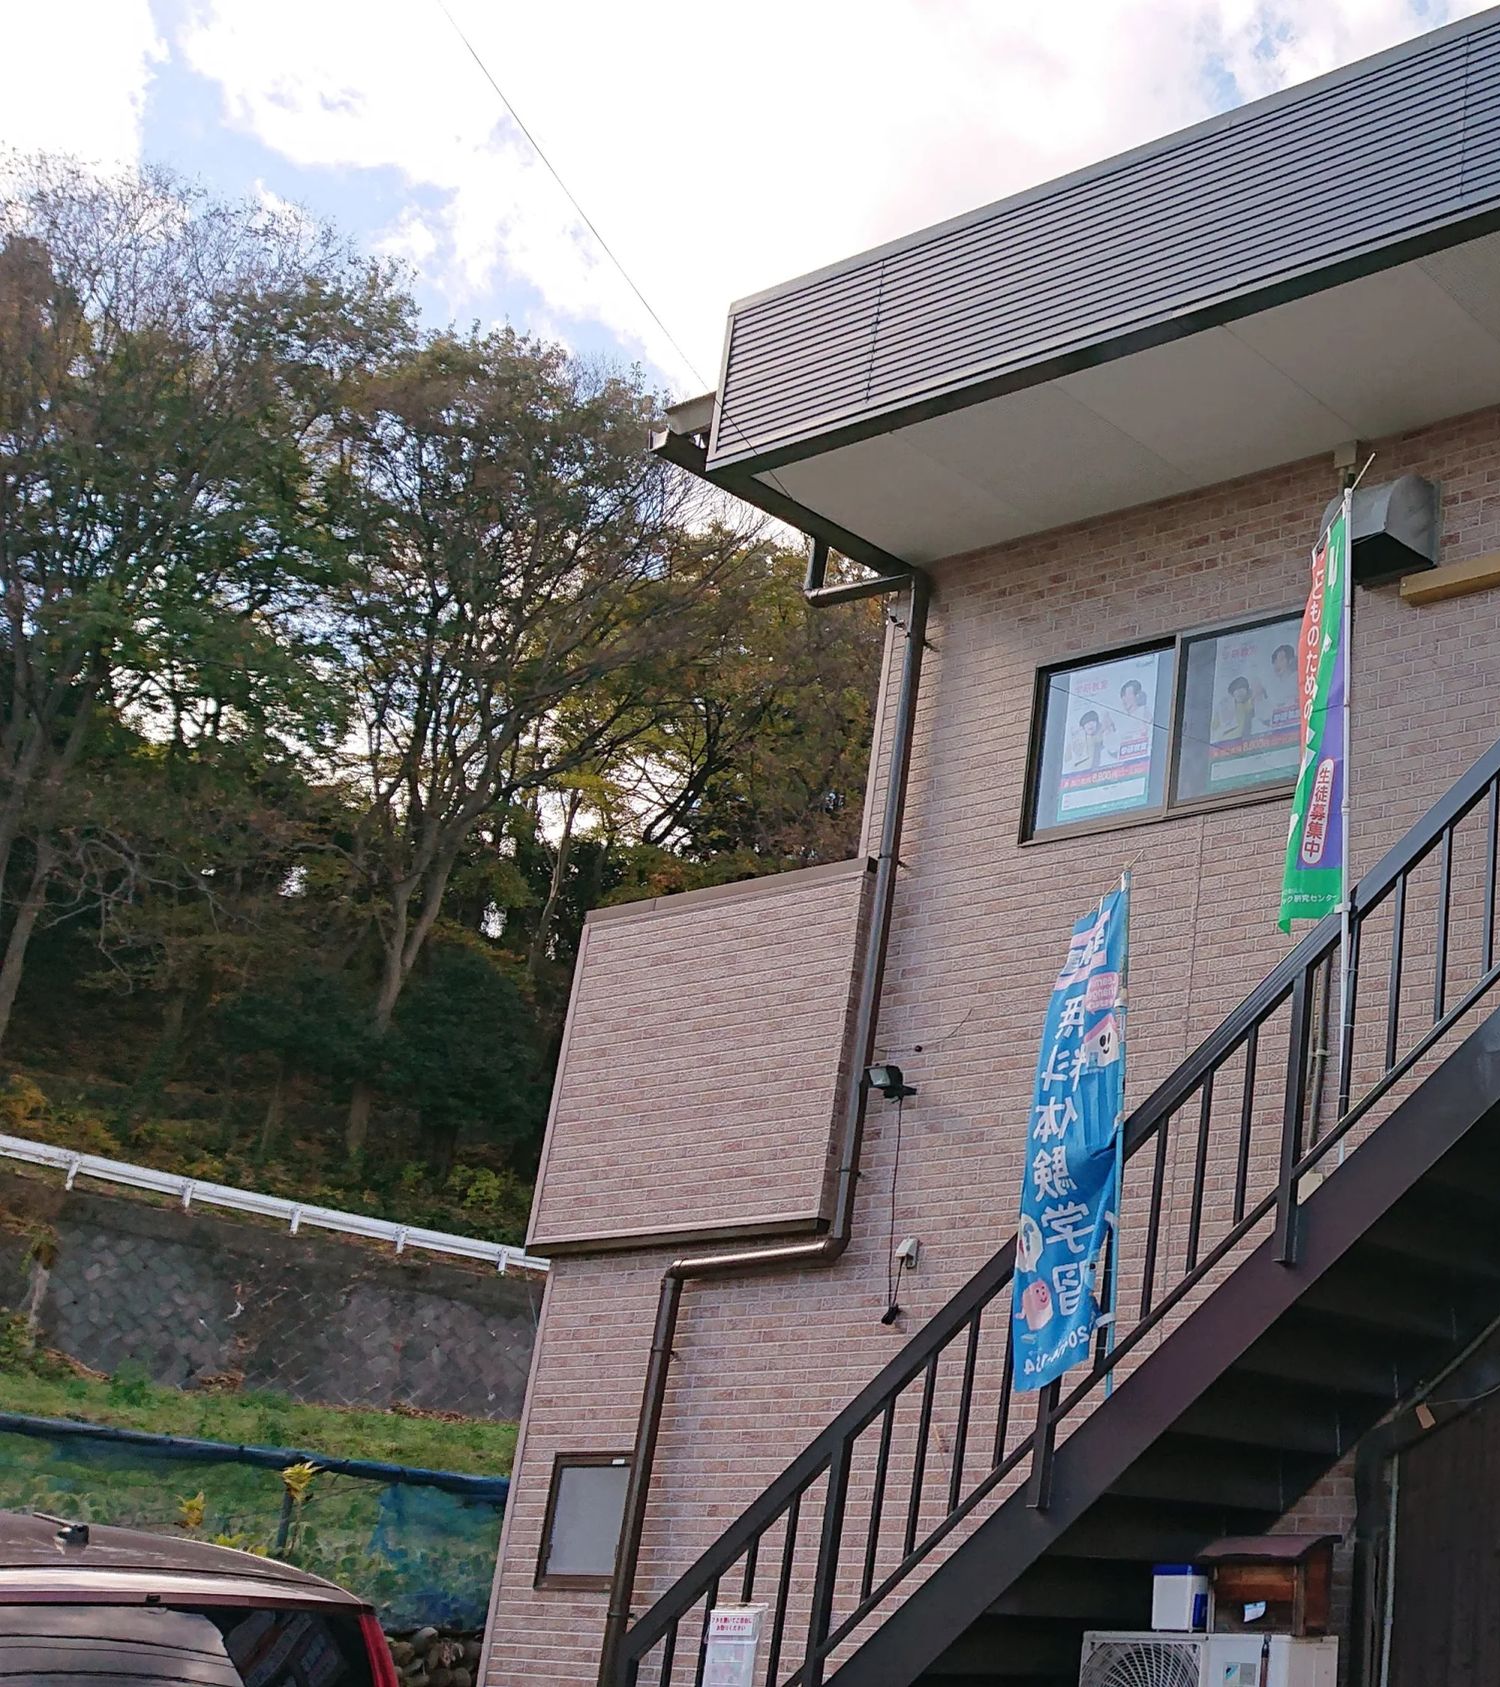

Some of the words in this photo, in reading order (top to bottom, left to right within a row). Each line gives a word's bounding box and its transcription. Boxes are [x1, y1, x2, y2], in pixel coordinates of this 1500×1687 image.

[1304, 768, 1330, 857] 生徒募集中
